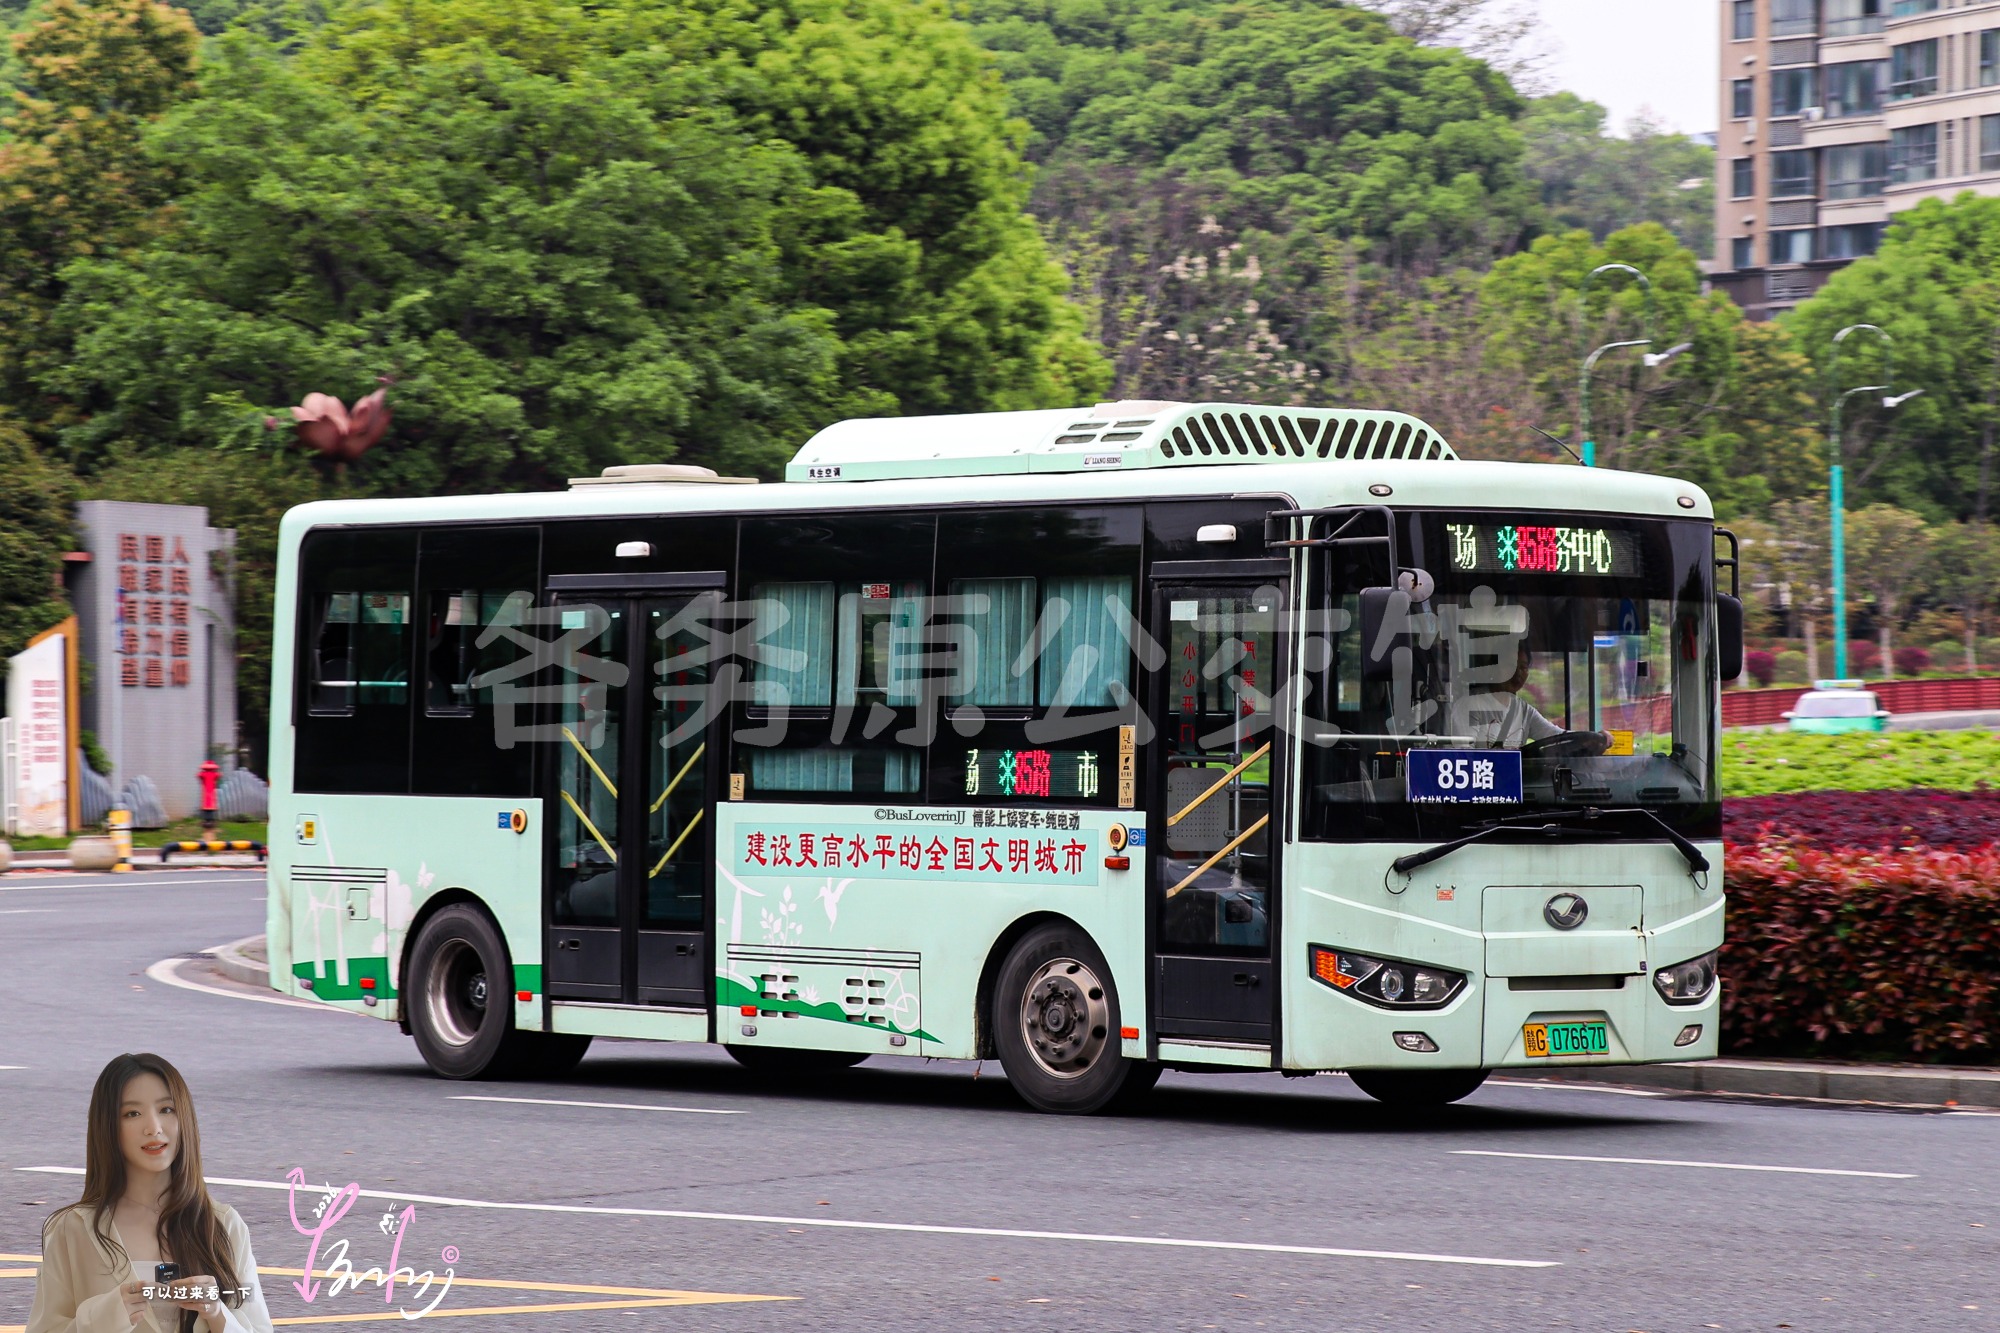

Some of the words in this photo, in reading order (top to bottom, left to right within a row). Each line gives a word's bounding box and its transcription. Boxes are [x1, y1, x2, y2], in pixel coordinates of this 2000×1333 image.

[1437, 758, 1495, 790] 85路
[744, 830, 1088, 876] 建设更高水平的全国文明城市
